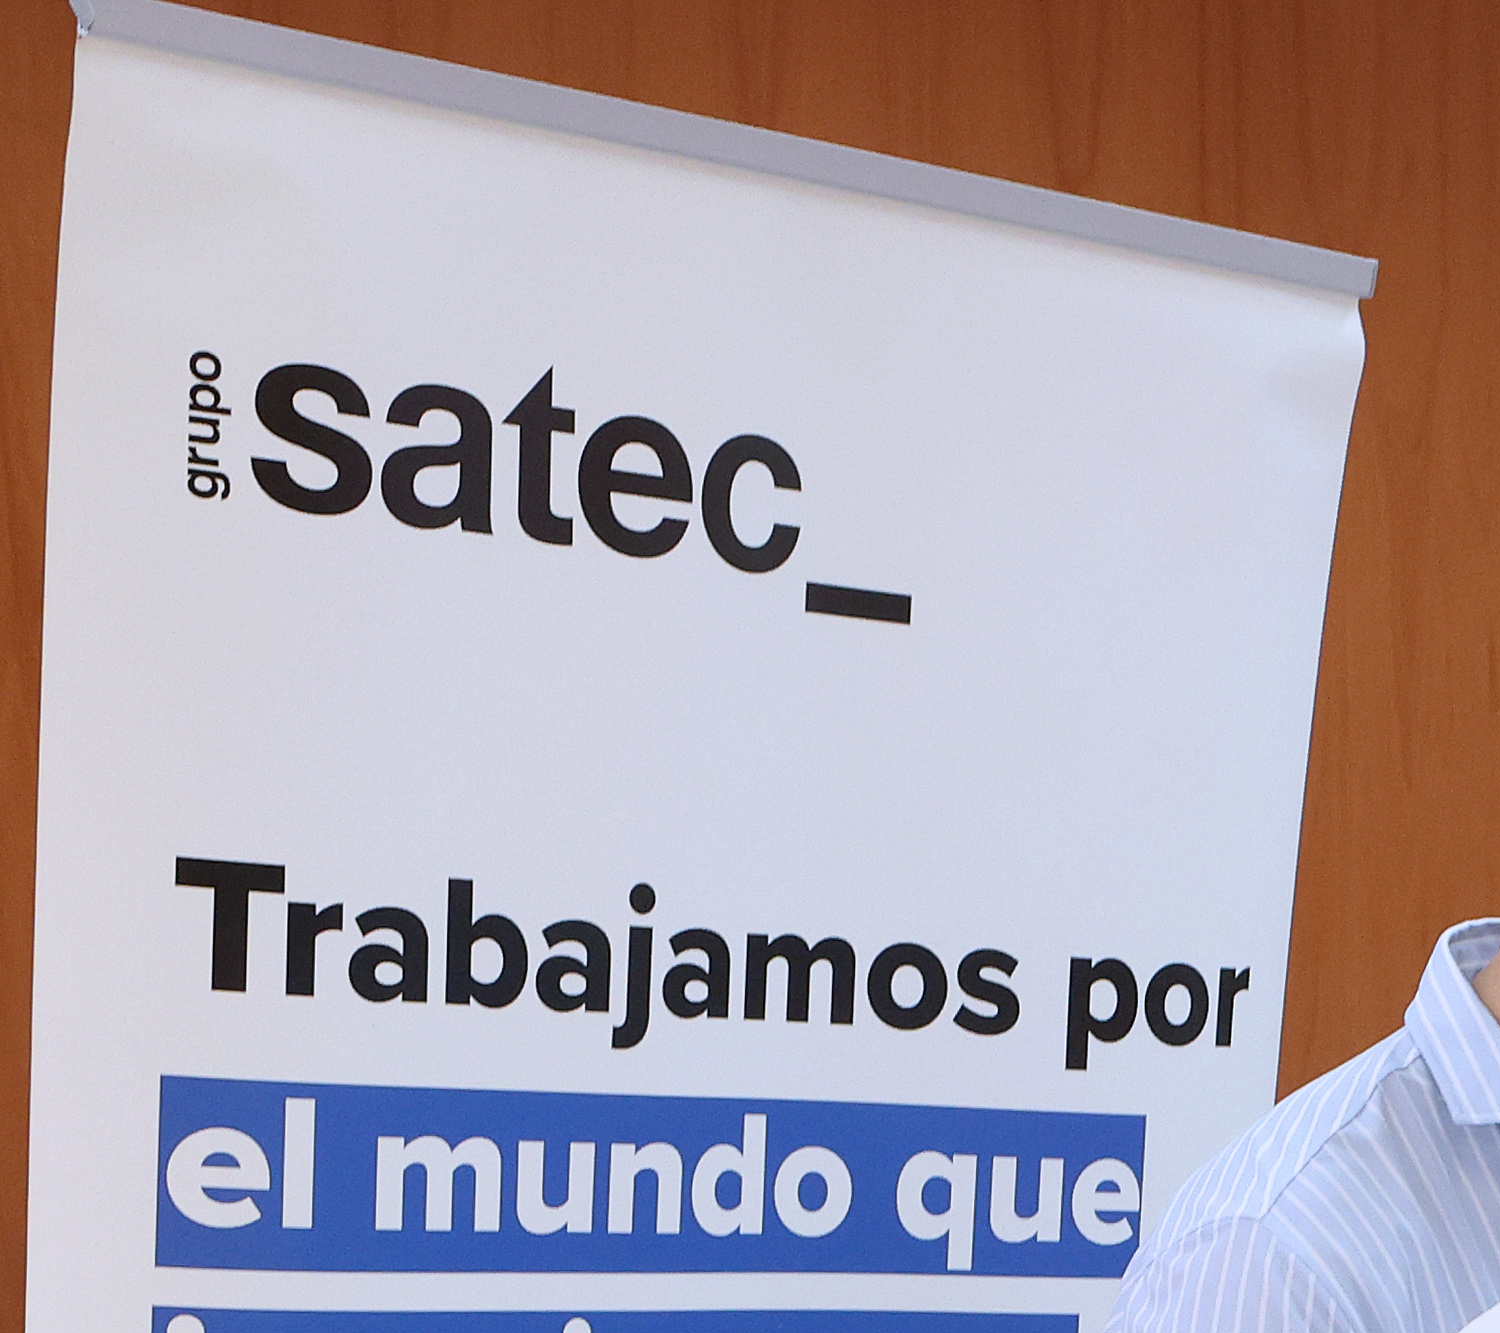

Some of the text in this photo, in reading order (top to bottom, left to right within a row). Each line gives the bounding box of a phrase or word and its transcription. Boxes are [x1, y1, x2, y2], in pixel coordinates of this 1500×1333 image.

[186, 350, 230, 500] grupo
[175, 857, 1250, 1071] Trabajamos por
[165, 1097, 1141, 1271] el mundo que
